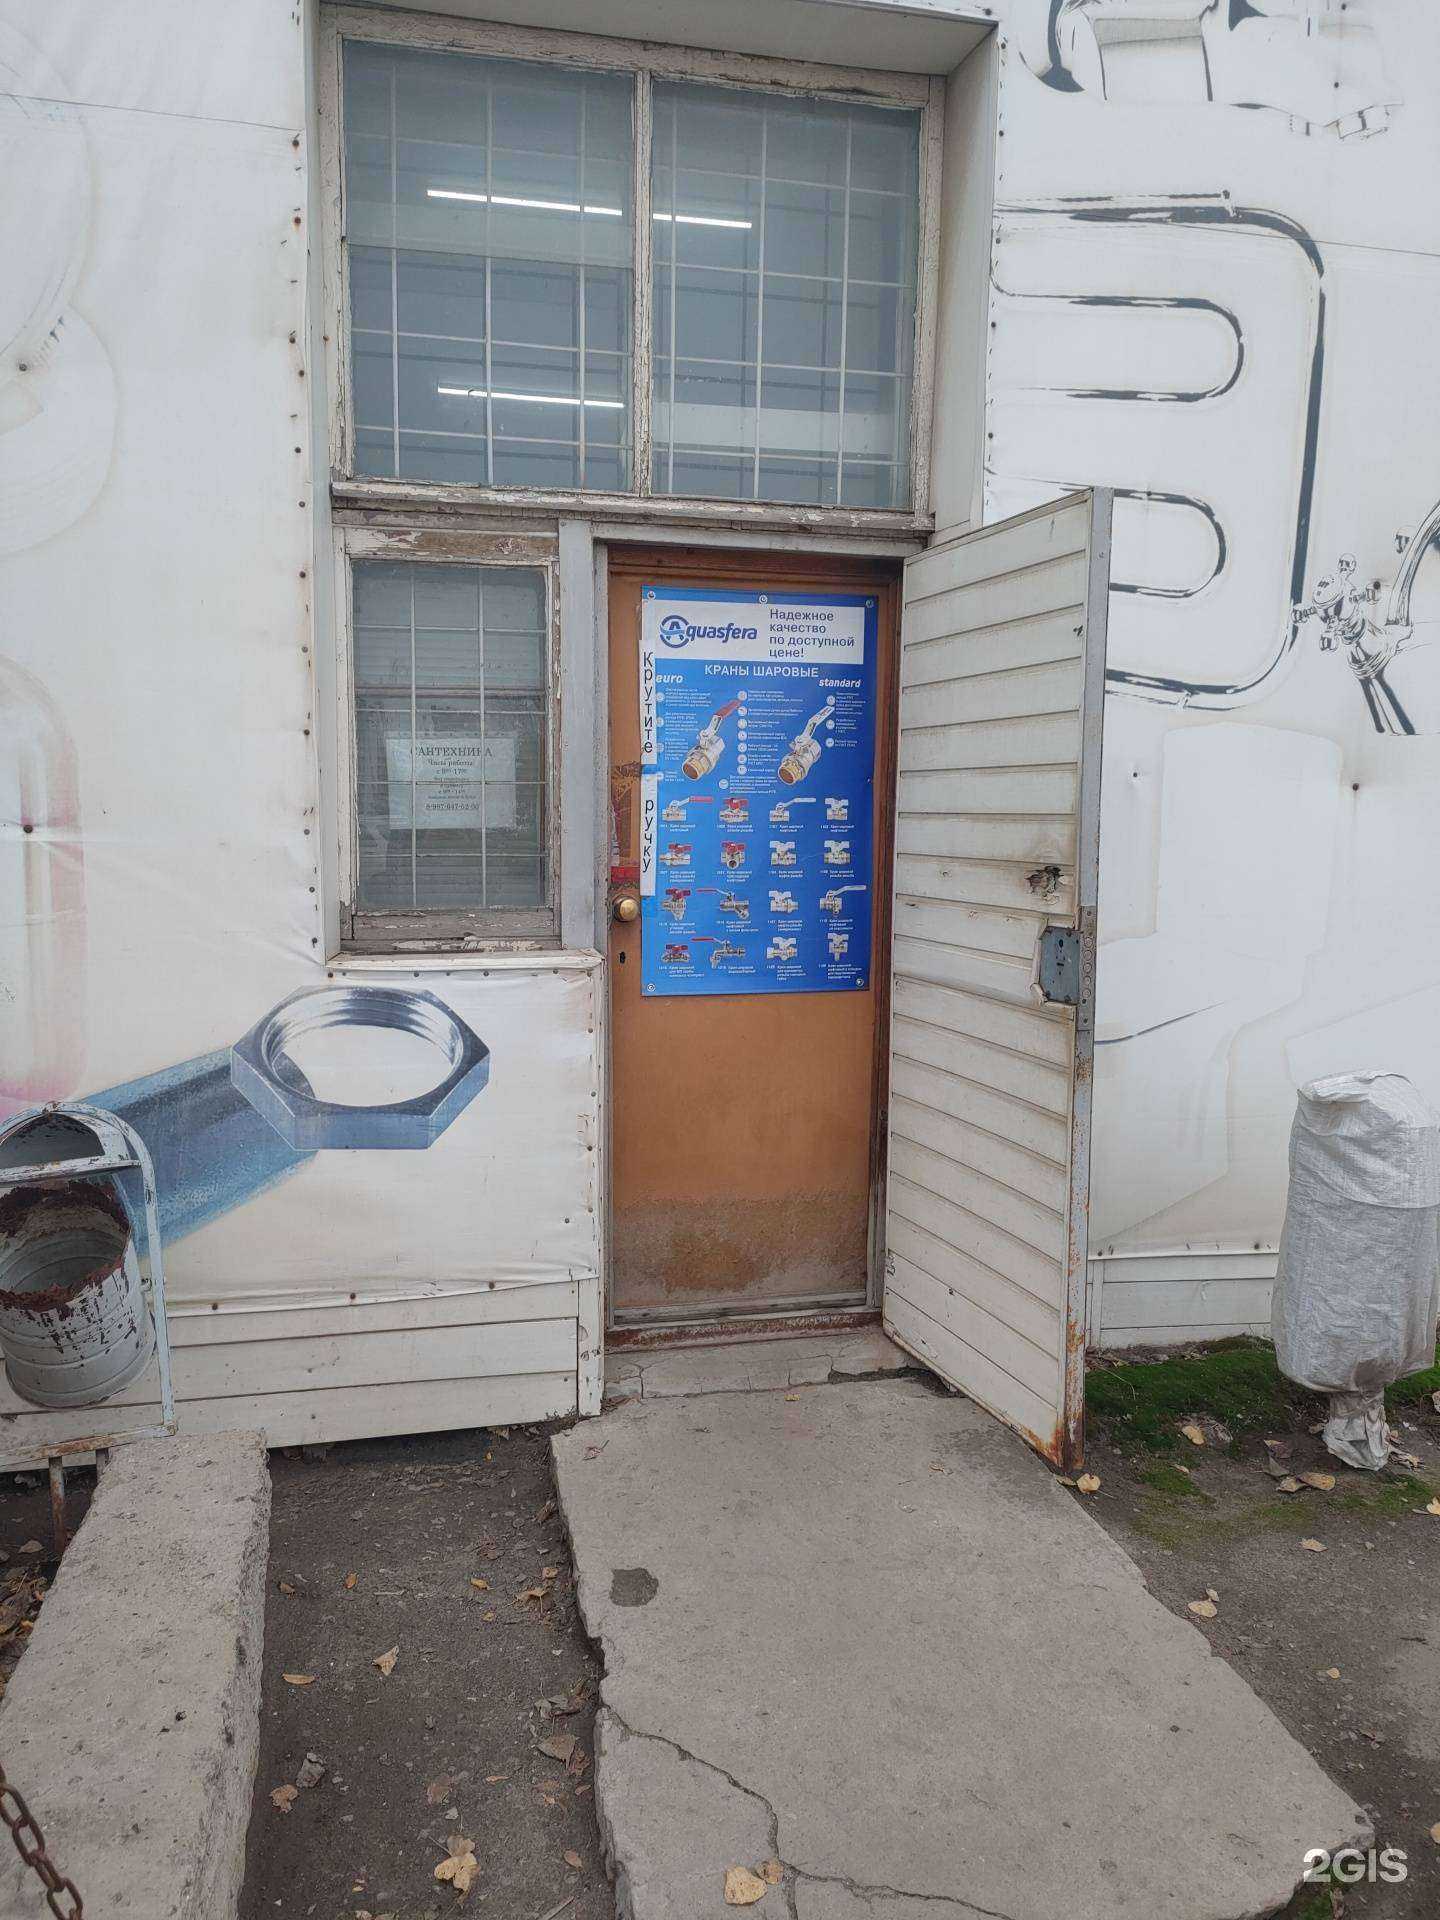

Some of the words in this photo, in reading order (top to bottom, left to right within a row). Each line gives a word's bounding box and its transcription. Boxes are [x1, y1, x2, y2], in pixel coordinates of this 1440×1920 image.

[769, 608, 835, 622] Надежное
[662, 617, 758, 646] Aquasfera
[769, 622, 827, 634] качество
[769, 636, 785, 645] по
[787, 635, 855, 648] доступной
[769, 646, 805, 659] цене!
[704, 664, 750, 676] КРАНЫ
[752, 665, 819, 678] ШАРОВЫЕ
[655, 674, 684, 683] euro
[818, 677, 862, 688] standard
[642, 799, 654, 873] ручку
